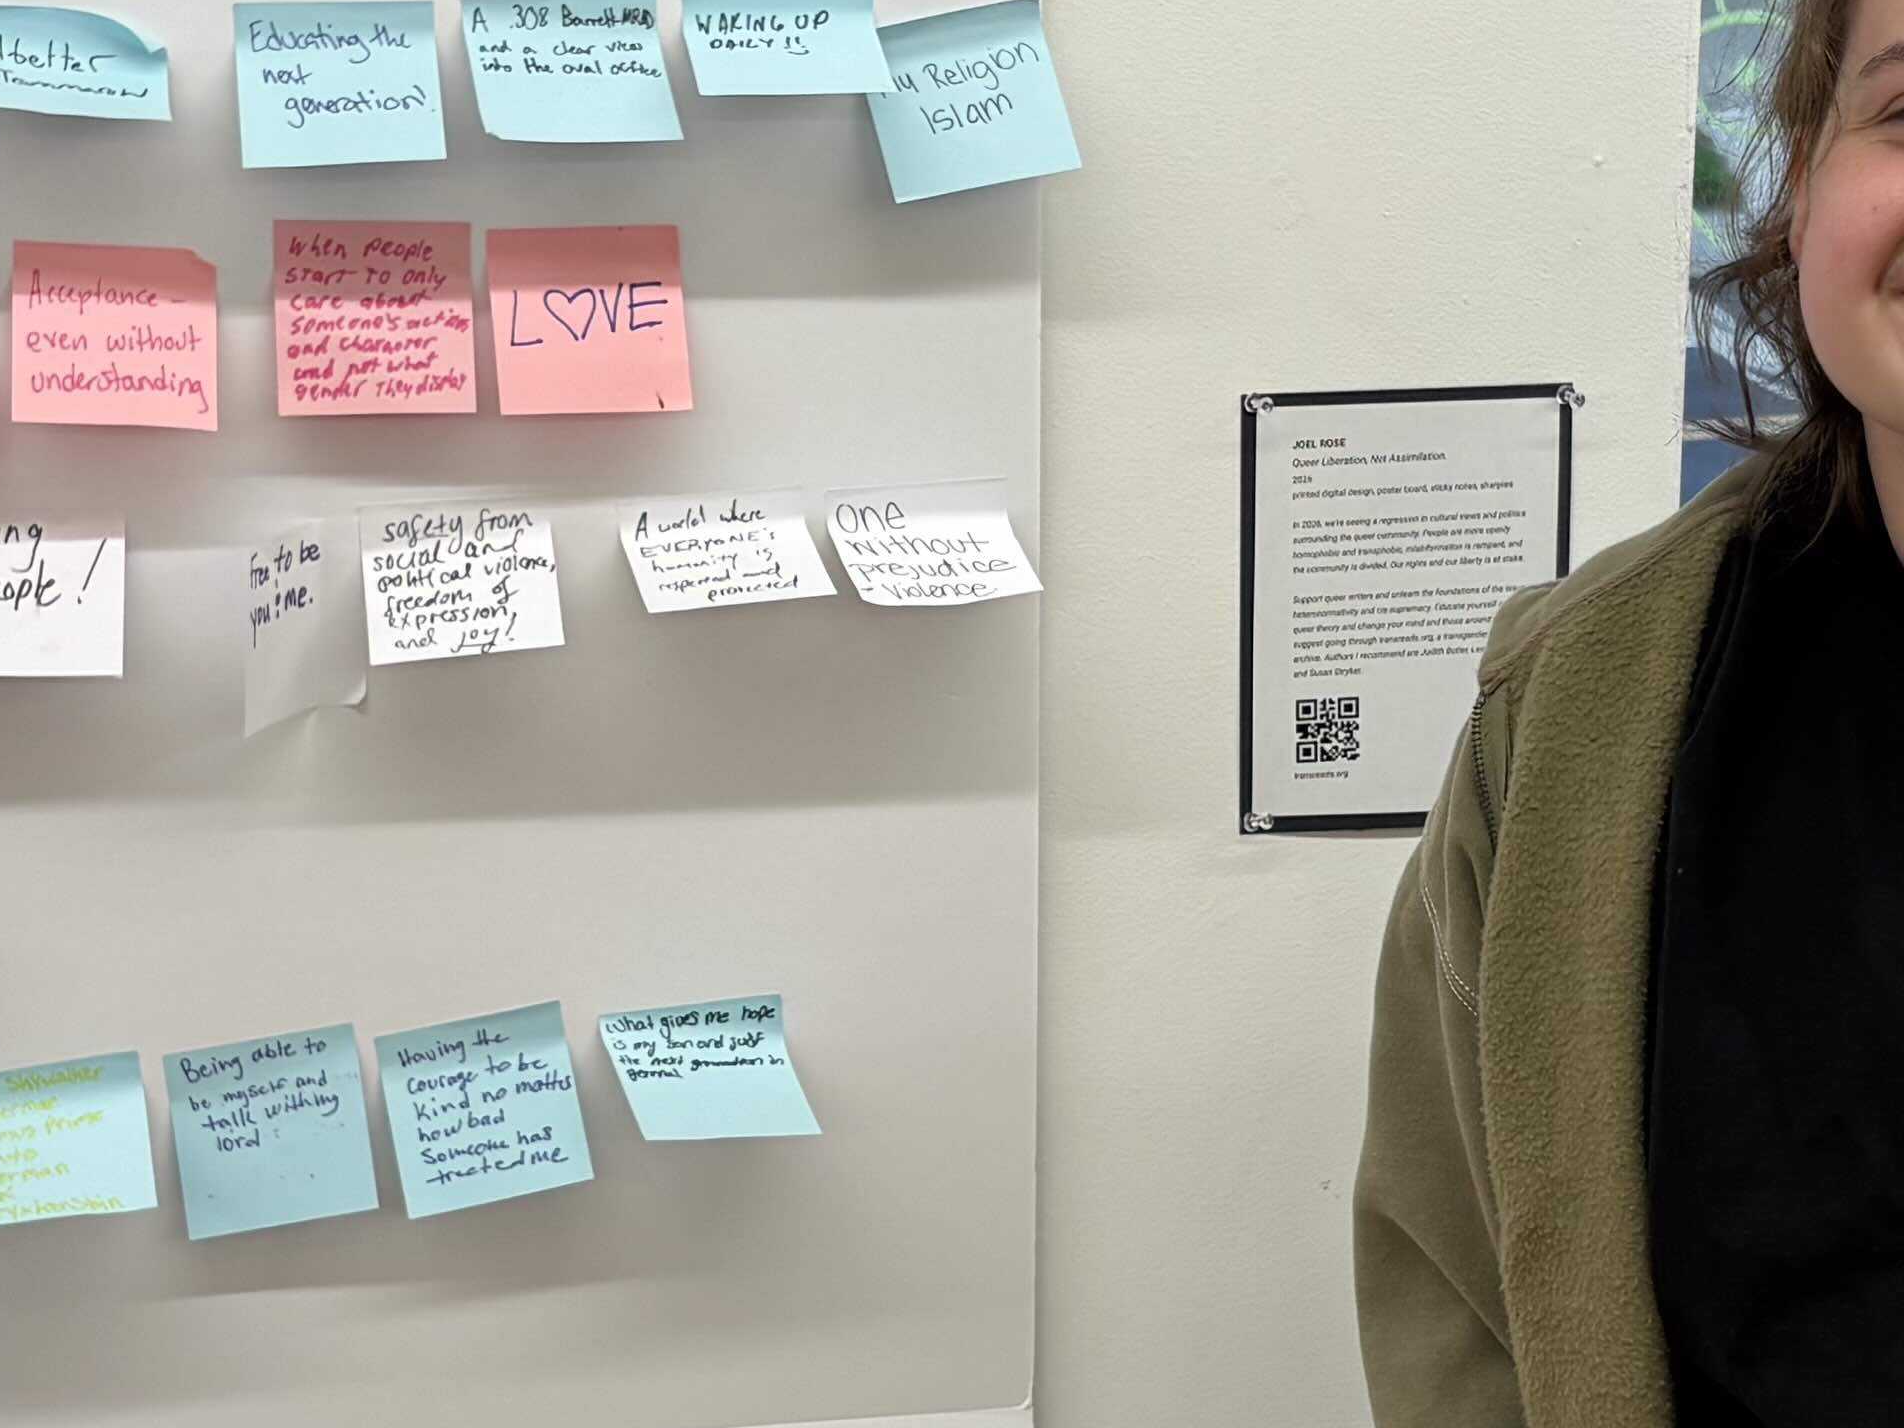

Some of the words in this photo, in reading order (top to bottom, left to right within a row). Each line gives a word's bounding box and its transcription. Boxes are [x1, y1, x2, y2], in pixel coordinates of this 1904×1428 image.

[696, 11, 787, 37] WAKING
[794, 9, 830, 32] UP
[250, 20, 371, 68] Educating
[376, 25, 412, 53] the
[262, 65, 311, 89] next
[926, 37, 1041, 94] Religion
[924, 94, 1016, 138] Islam
[29, 269, 159, 315] Acceptance
[26, 331, 87, 352] even
[106, 325, 202, 354] without
[32, 364, 210, 414] understanding
[1292, 456, 1320, 469] Queer
[1390, 451, 1446, 463] Assimilation
[1319, 438, 1346, 449] ROSE
